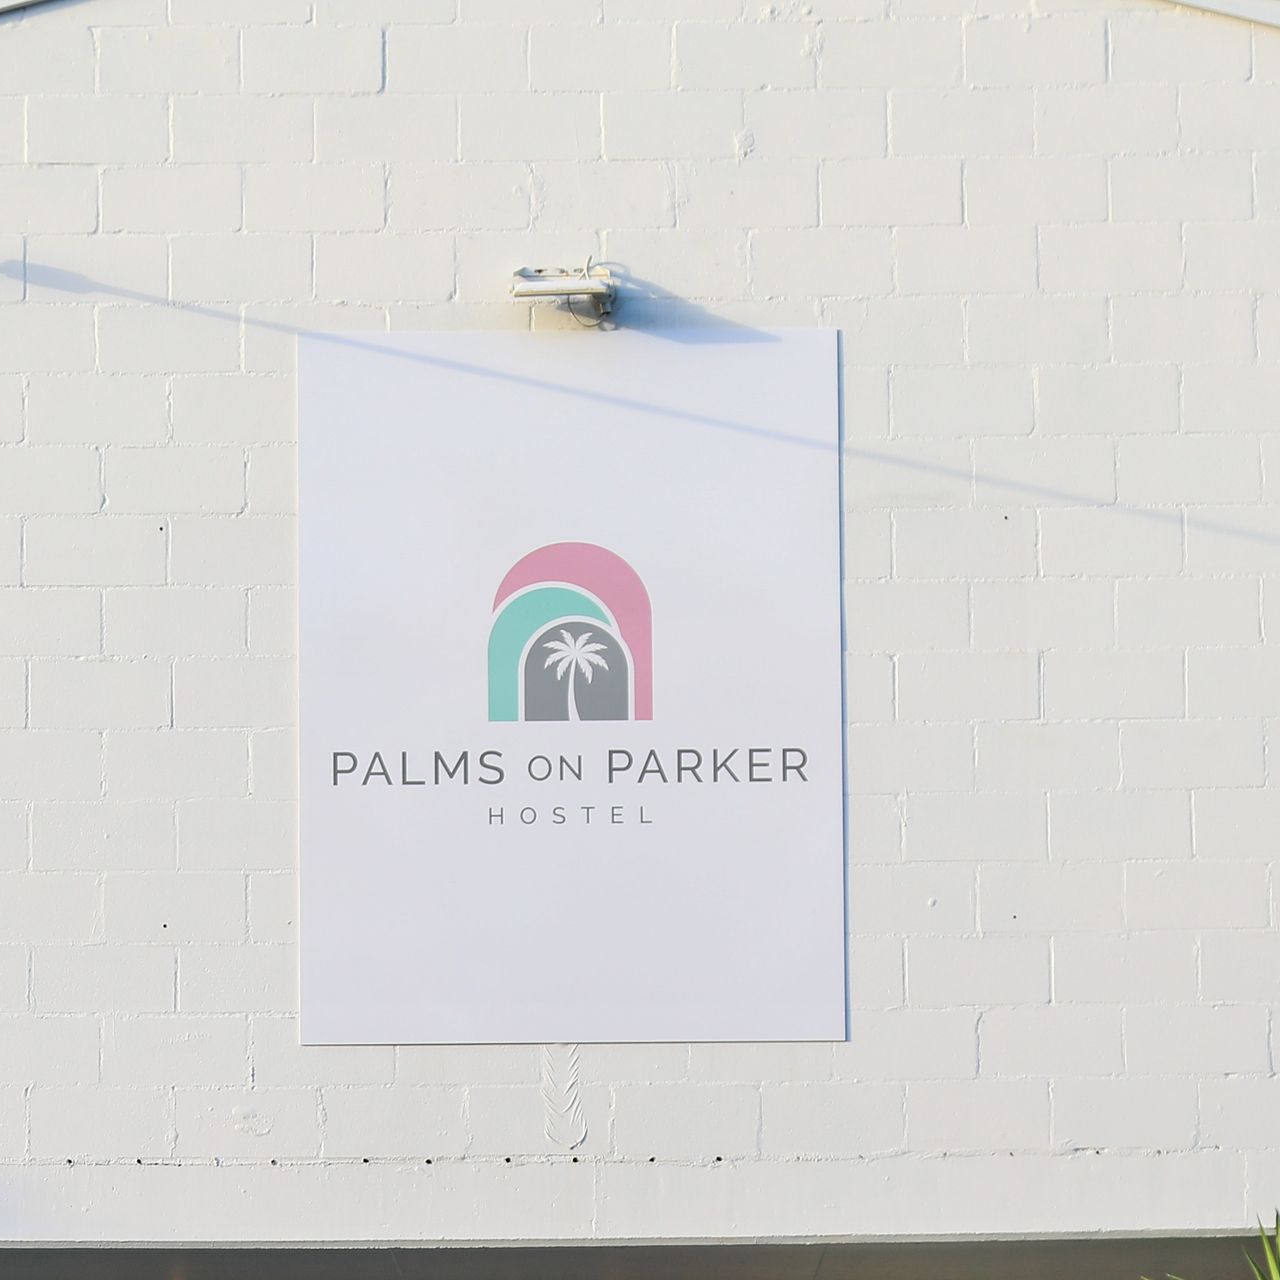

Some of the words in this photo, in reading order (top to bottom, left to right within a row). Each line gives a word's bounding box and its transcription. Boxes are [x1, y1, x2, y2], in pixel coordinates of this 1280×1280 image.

[332, 750, 506, 786] PALMS
[527, 754, 583, 782] ON
[607, 748, 810, 784] PARKER
[488, 805, 653, 825] HOSTEL
